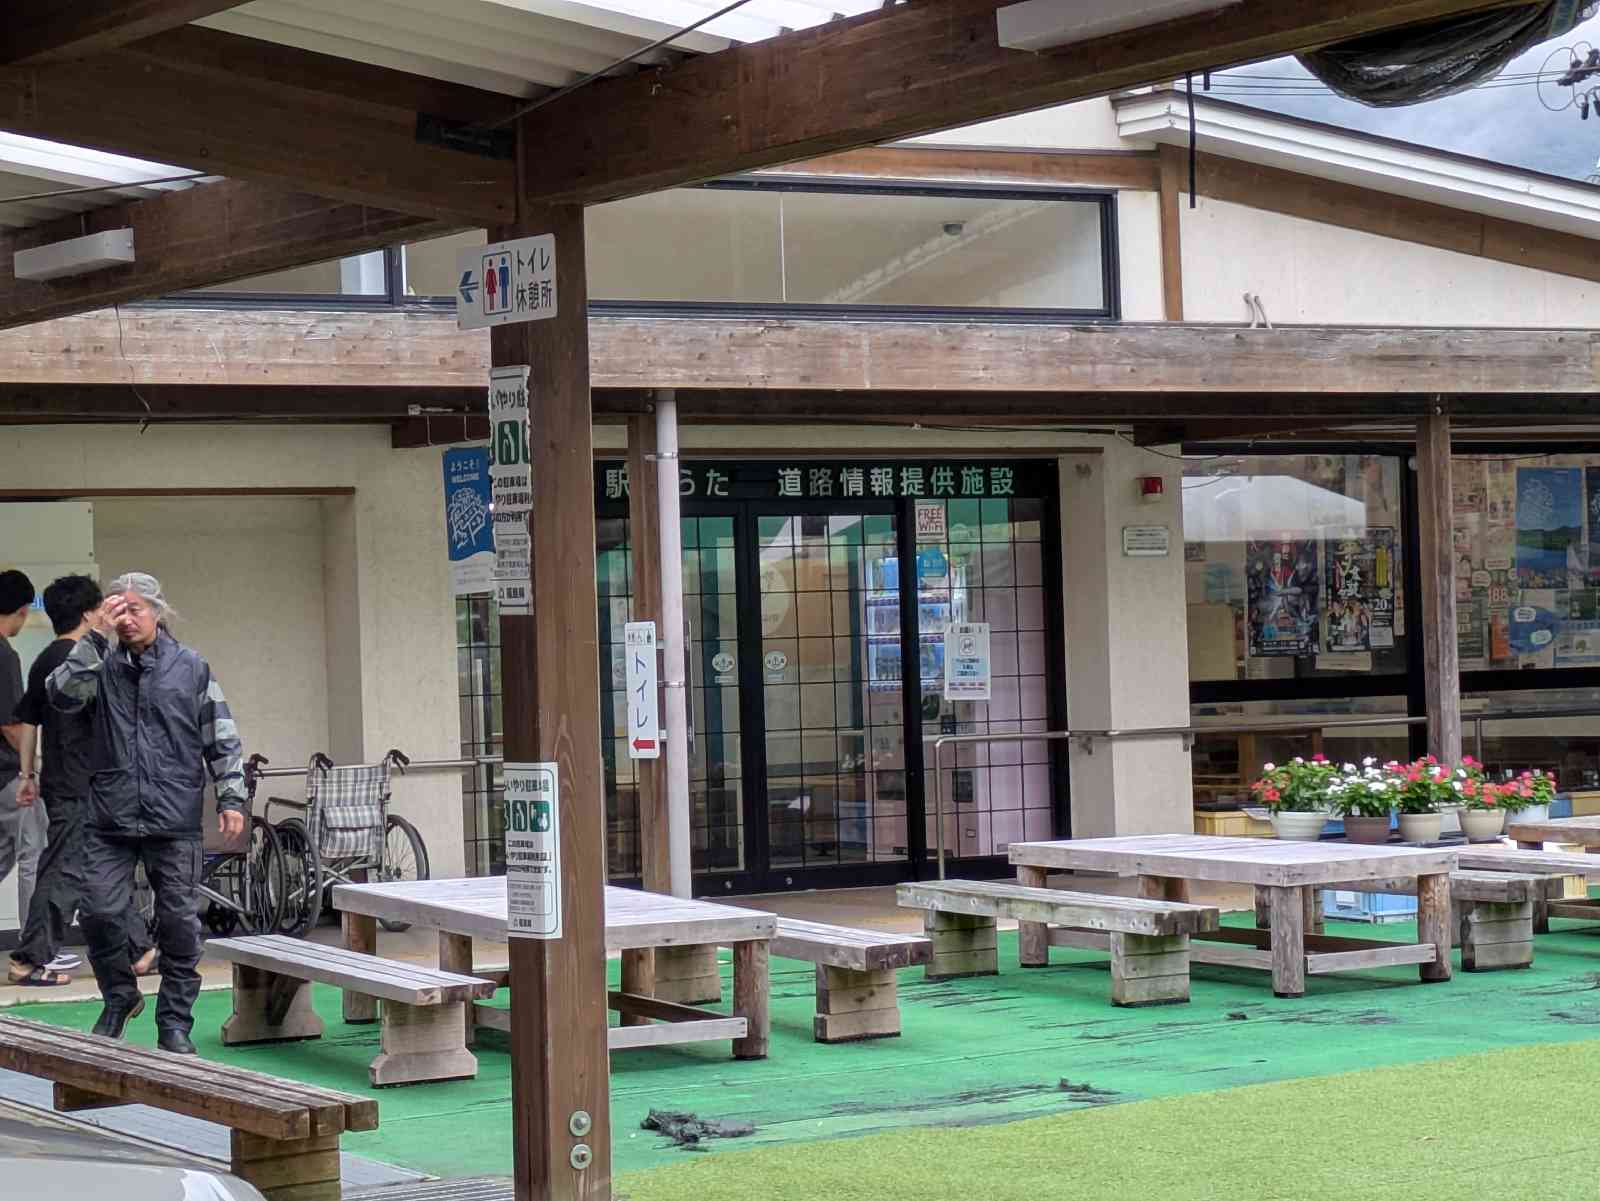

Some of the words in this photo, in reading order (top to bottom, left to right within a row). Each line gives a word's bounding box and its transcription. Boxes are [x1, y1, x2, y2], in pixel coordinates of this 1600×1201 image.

[516, 248, 551, 275] トイレ
[516, 280, 552, 312] 休憩所
[778, 466, 1015, 497] 道路情報提供施設
[918, 507, 943, 520] FREE
[634, 651, 649, 729] トイレ
